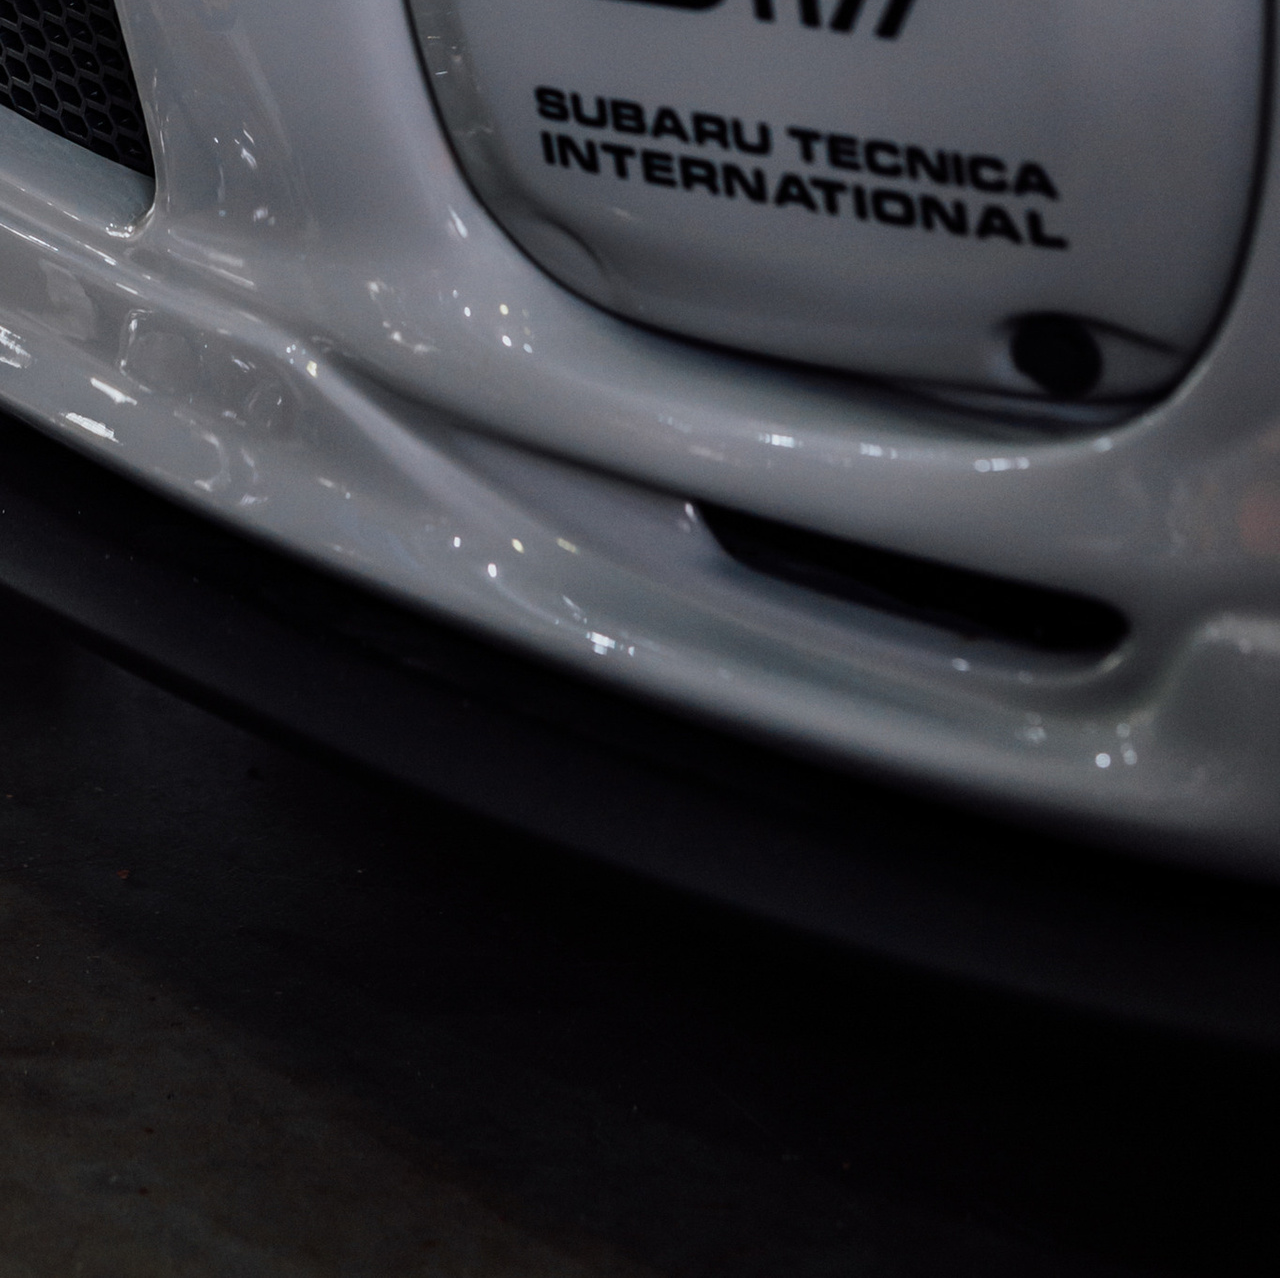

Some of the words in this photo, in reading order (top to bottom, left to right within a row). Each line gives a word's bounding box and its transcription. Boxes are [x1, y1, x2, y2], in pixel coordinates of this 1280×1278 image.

[533, 84, 773, 157] SUBARU
[786, 124, 1061, 201] TECNICA
[539, 130, 1071, 250] INTERNATIONAL
